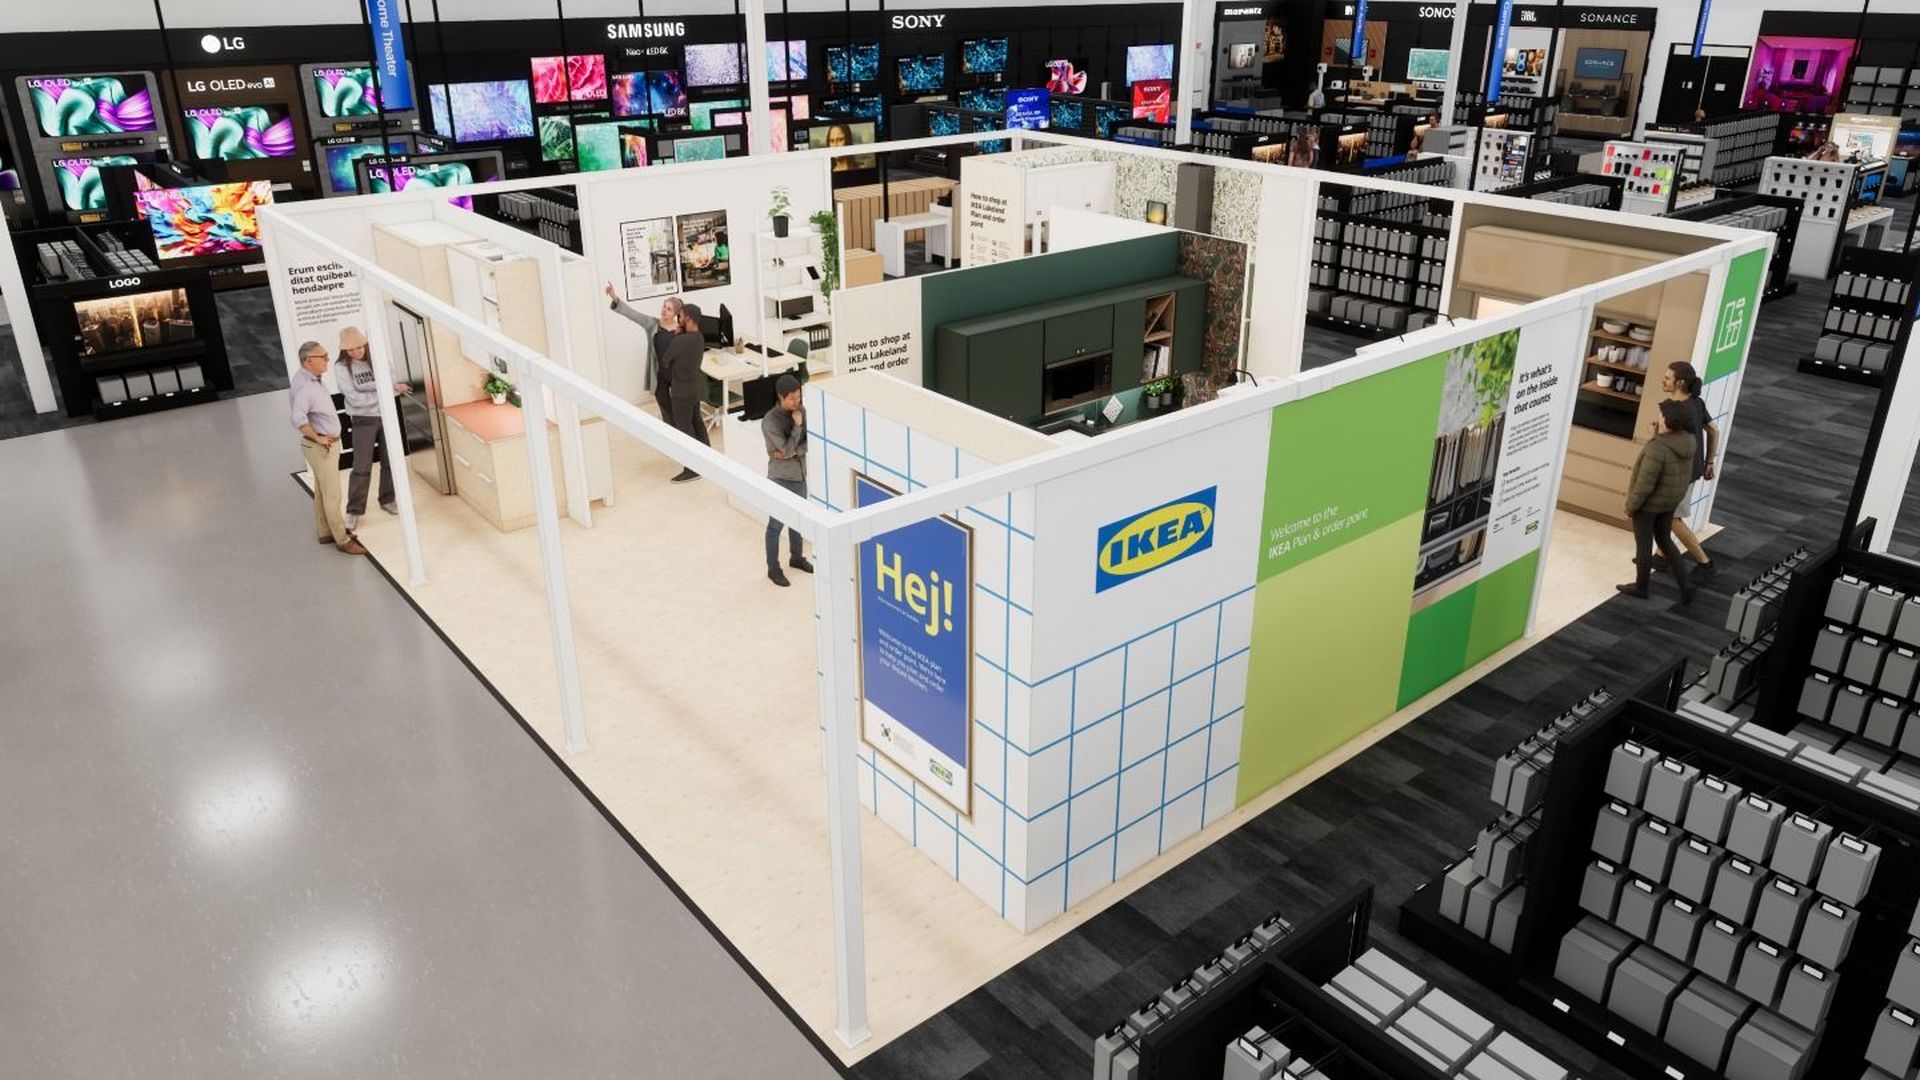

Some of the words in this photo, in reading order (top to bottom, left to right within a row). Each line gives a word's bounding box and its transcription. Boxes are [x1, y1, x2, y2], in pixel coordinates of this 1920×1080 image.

[377, 0, 389, 28] ome
[1580, 13, 1638, 24] SONANCE
[892, 14, 945, 29] SONY
[607, 22, 685, 39] SAMSUNG
[223, 37, 245, 50] LG
[382, 30, 397, 77] Theater
[27, 79, 42, 88] LG
[44, 78, 71, 87] OLED
[187, 80, 206, 92] LG
[210, 79, 246, 91] OLED
[369, 168, 384, 180] LG
[288, 267, 315, 276] Erum
[108, 276, 141, 289] LOGO
[290, 276, 315, 286] ditat
[292, 281, 345, 295] hendaepre
[848, 341, 868, 353] How
[869, 339, 878, 348] to
[880, 335, 900, 346] shop
[902, 332, 911, 340] at
[849, 354, 868, 365] IKEA
[870, 344, 908, 360] Lakeland
[886, 357, 909, 369] order
[1526, 383, 1538, 396] the
[1529, 393, 1552, 409] counts
[1270, 516, 1312, 542] Welcome
[1312, 512, 1323, 524] to
[1323, 506, 1339, 520] the
[1109, 509, 1205, 568] IKEA
[1268, 540, 1291, 560] IKEA
[1292, 534, 1312, 549] Plan
[1312, 528, 1321, 540] &
[1321, 518, 1346, 537] order
[1345, 508, 1368, 529] point
[876, 543, 953, 637] Hej!
